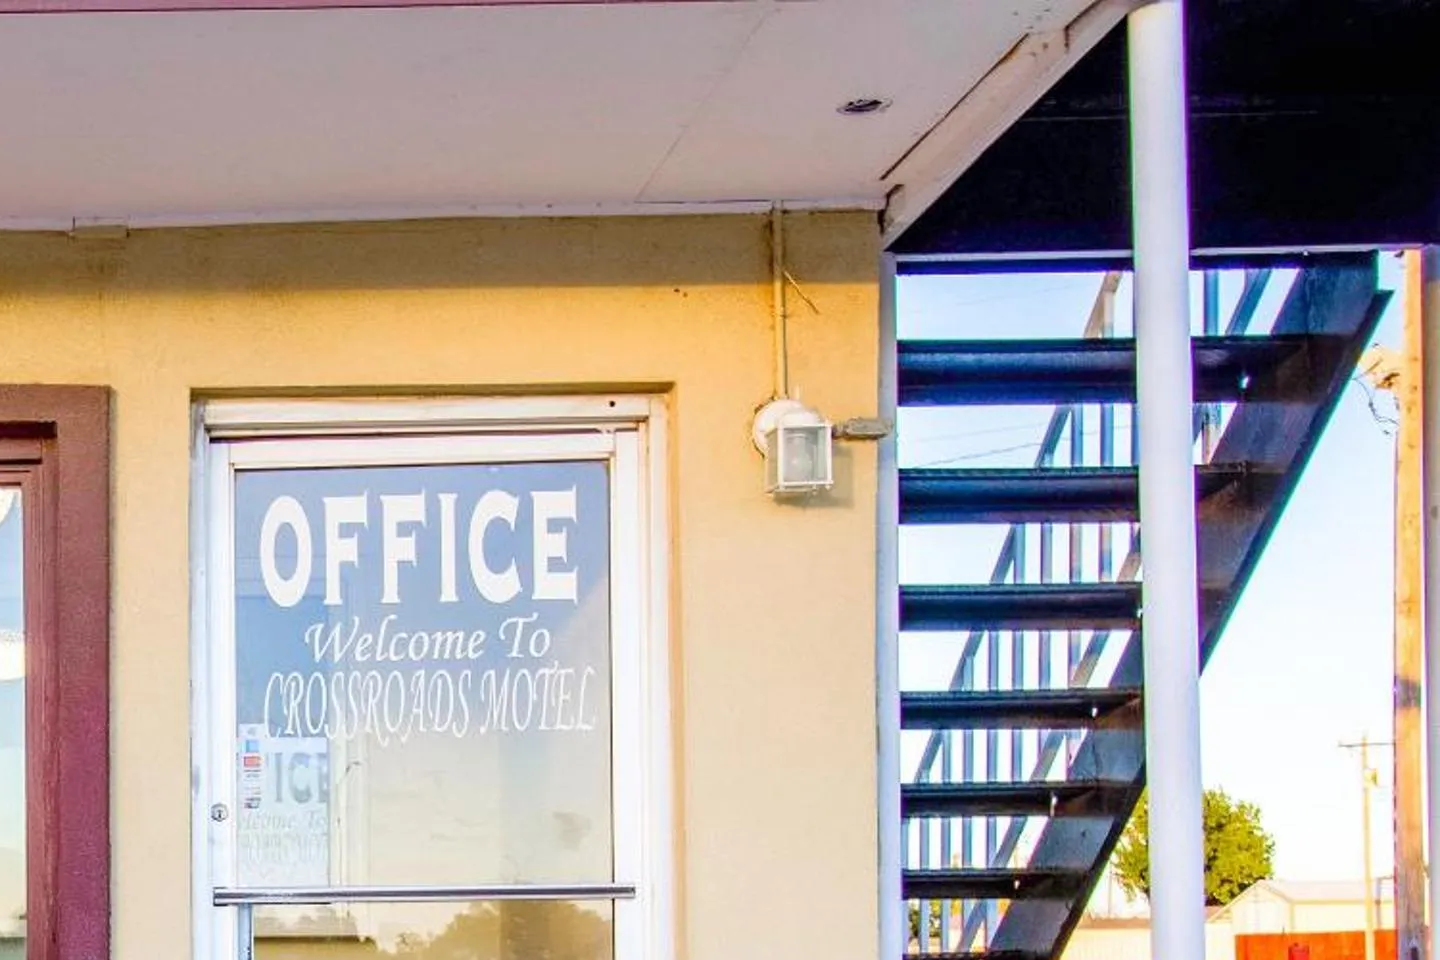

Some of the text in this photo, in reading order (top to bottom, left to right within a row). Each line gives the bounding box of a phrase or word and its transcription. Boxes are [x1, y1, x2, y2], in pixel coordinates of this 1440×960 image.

[260, 485, 578, 607] OFFICE
[305, 612, 551, 663] Welcome To
[264, 661, 596, 746] CROSSROADS MOTEL
